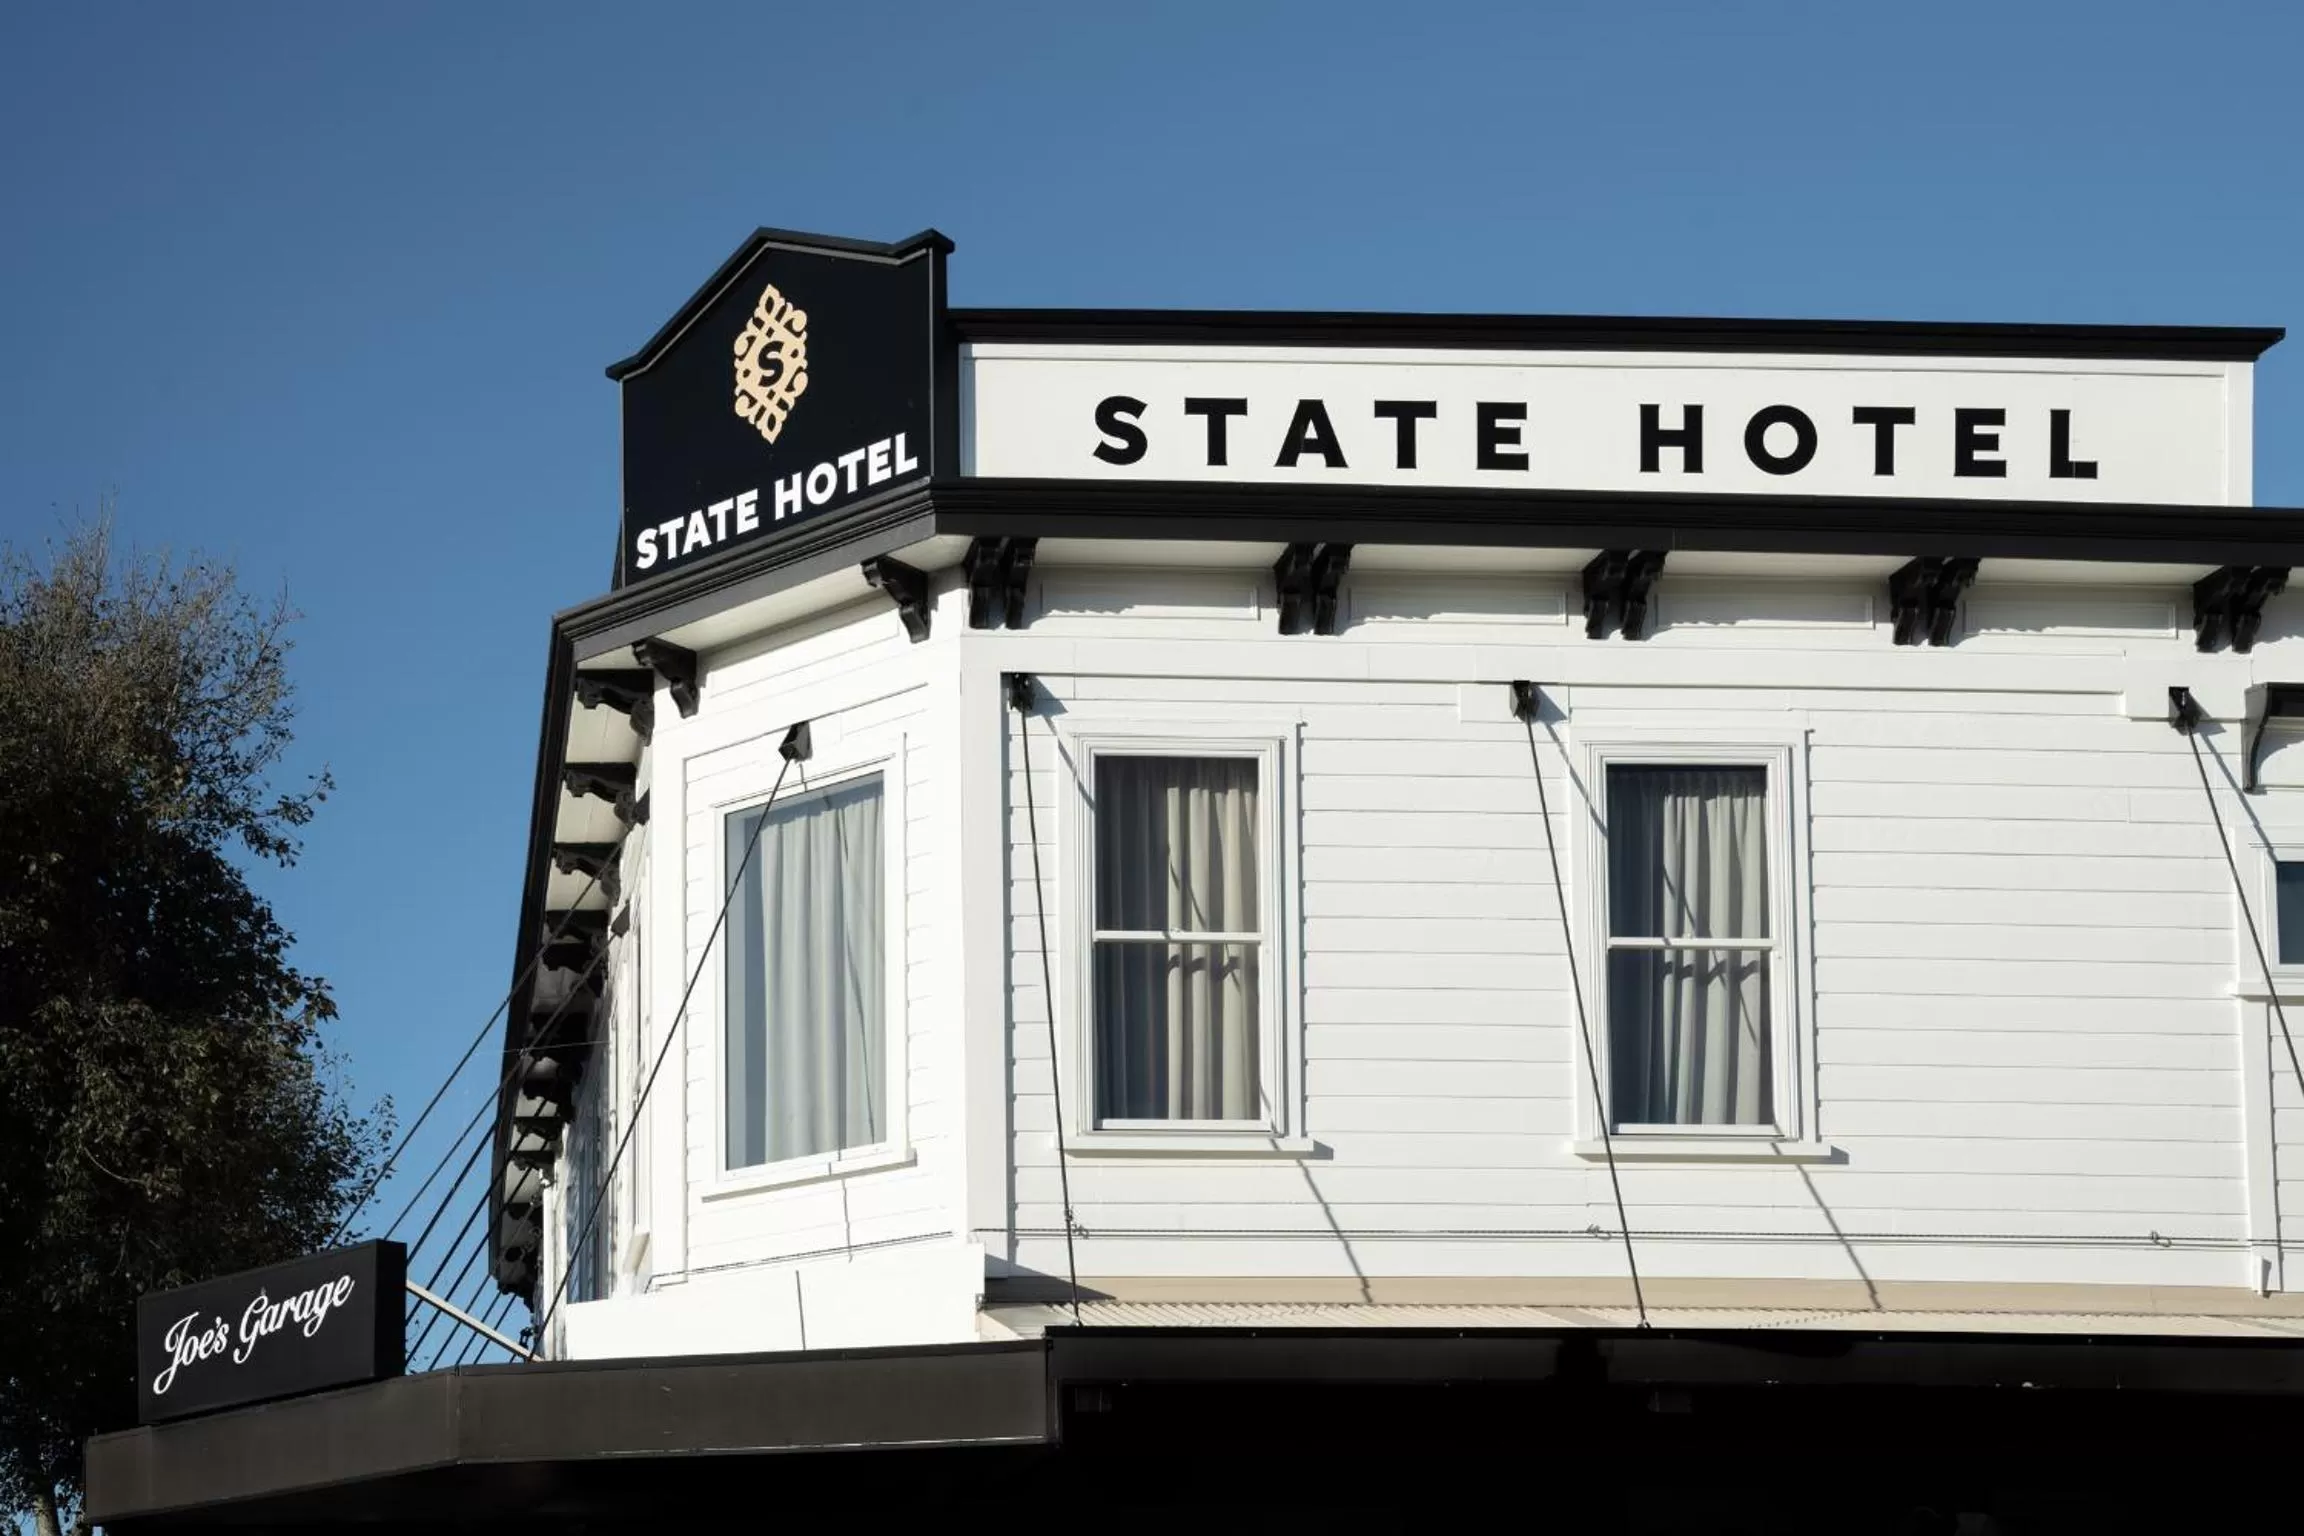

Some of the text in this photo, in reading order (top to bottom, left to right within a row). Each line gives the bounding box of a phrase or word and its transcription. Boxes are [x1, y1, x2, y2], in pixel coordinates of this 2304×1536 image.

[757, 340, 785, 388] S
[1093, 395, 2098, 480] STATE HOTEL
[635, 432, 918, 570] STATE HOTEL
[152, 1275, 356, 1395] Joe's Garage
